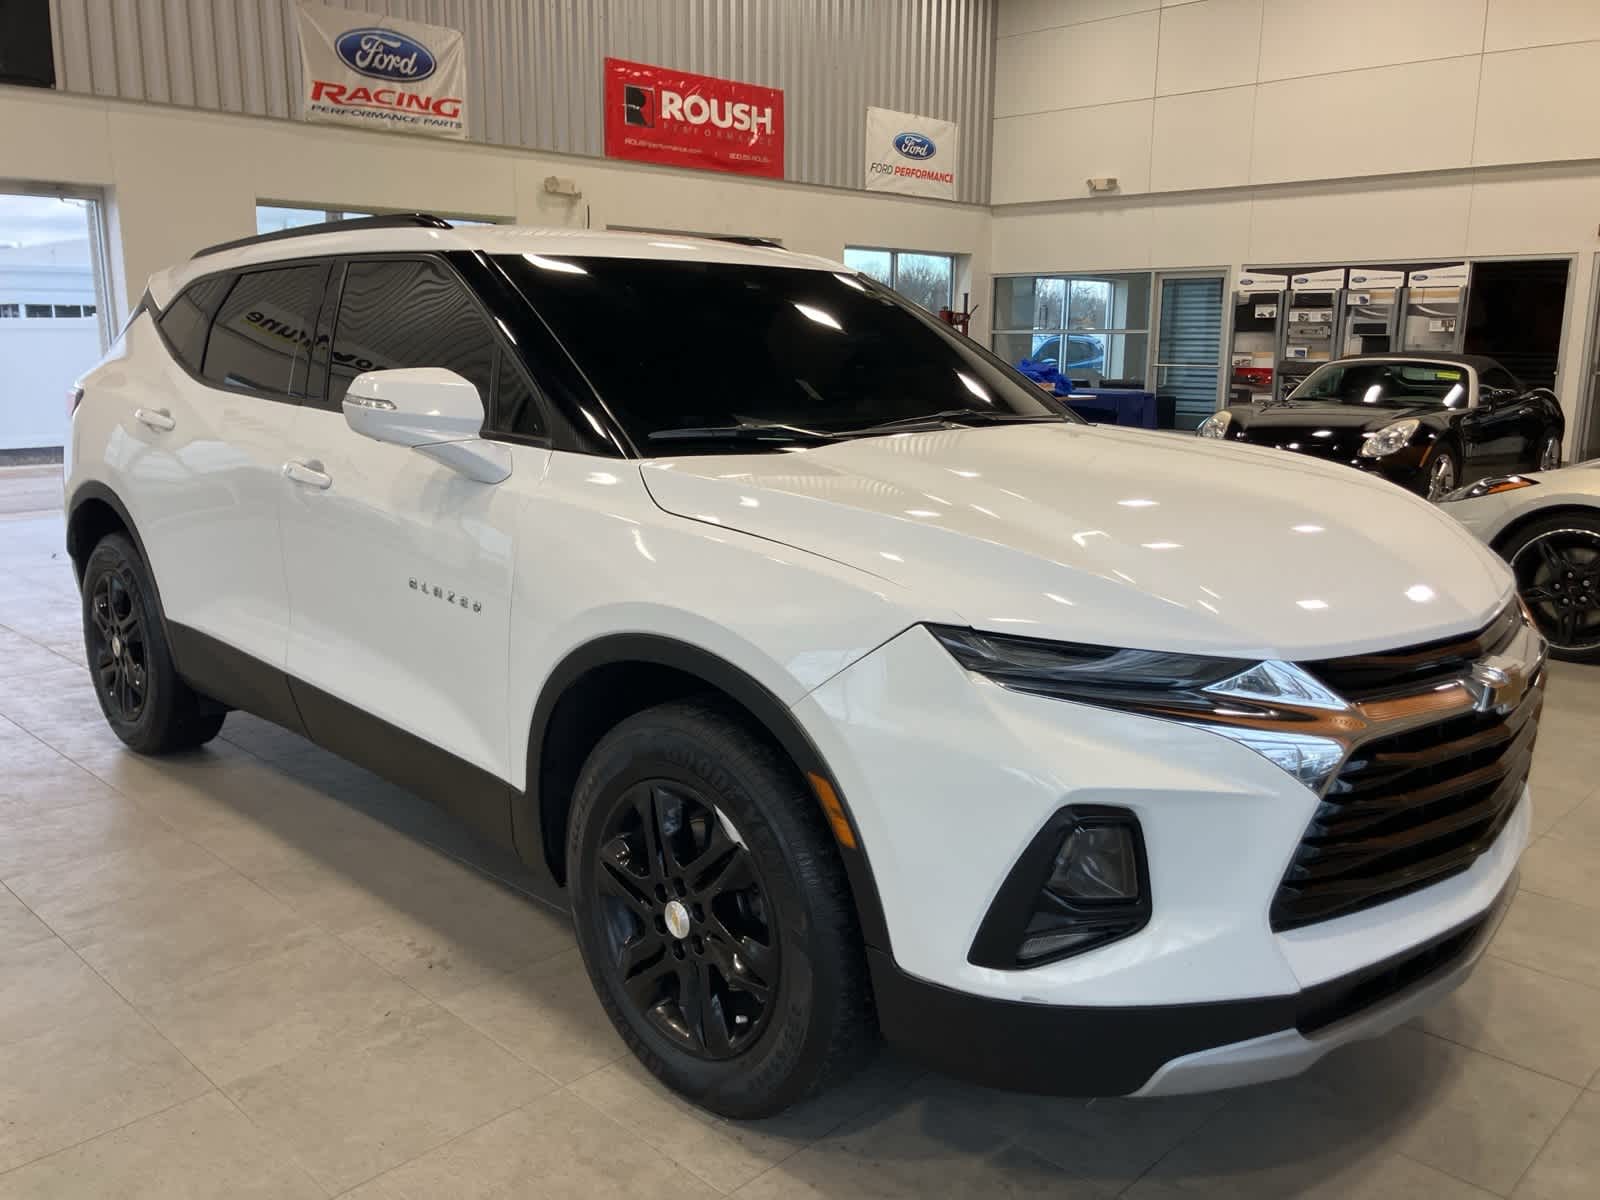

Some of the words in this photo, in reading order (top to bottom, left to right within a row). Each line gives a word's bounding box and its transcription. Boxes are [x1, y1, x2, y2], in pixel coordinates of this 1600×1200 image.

[355, 34, 418, 75] Ford
[311, 80, 462, 118] RACING
[311, 104, 419, 124] PERFORMANCE
[423, 119, 463, 129] PARTS
[661, 90, 773, 135] ROUSH
[901, 136, 928, 156] Ford
[870, 162, 893, 175] FORD
[894, 165, 954, 184] PERFORMANCE
[408, 577, 482, 613] BLAZER
